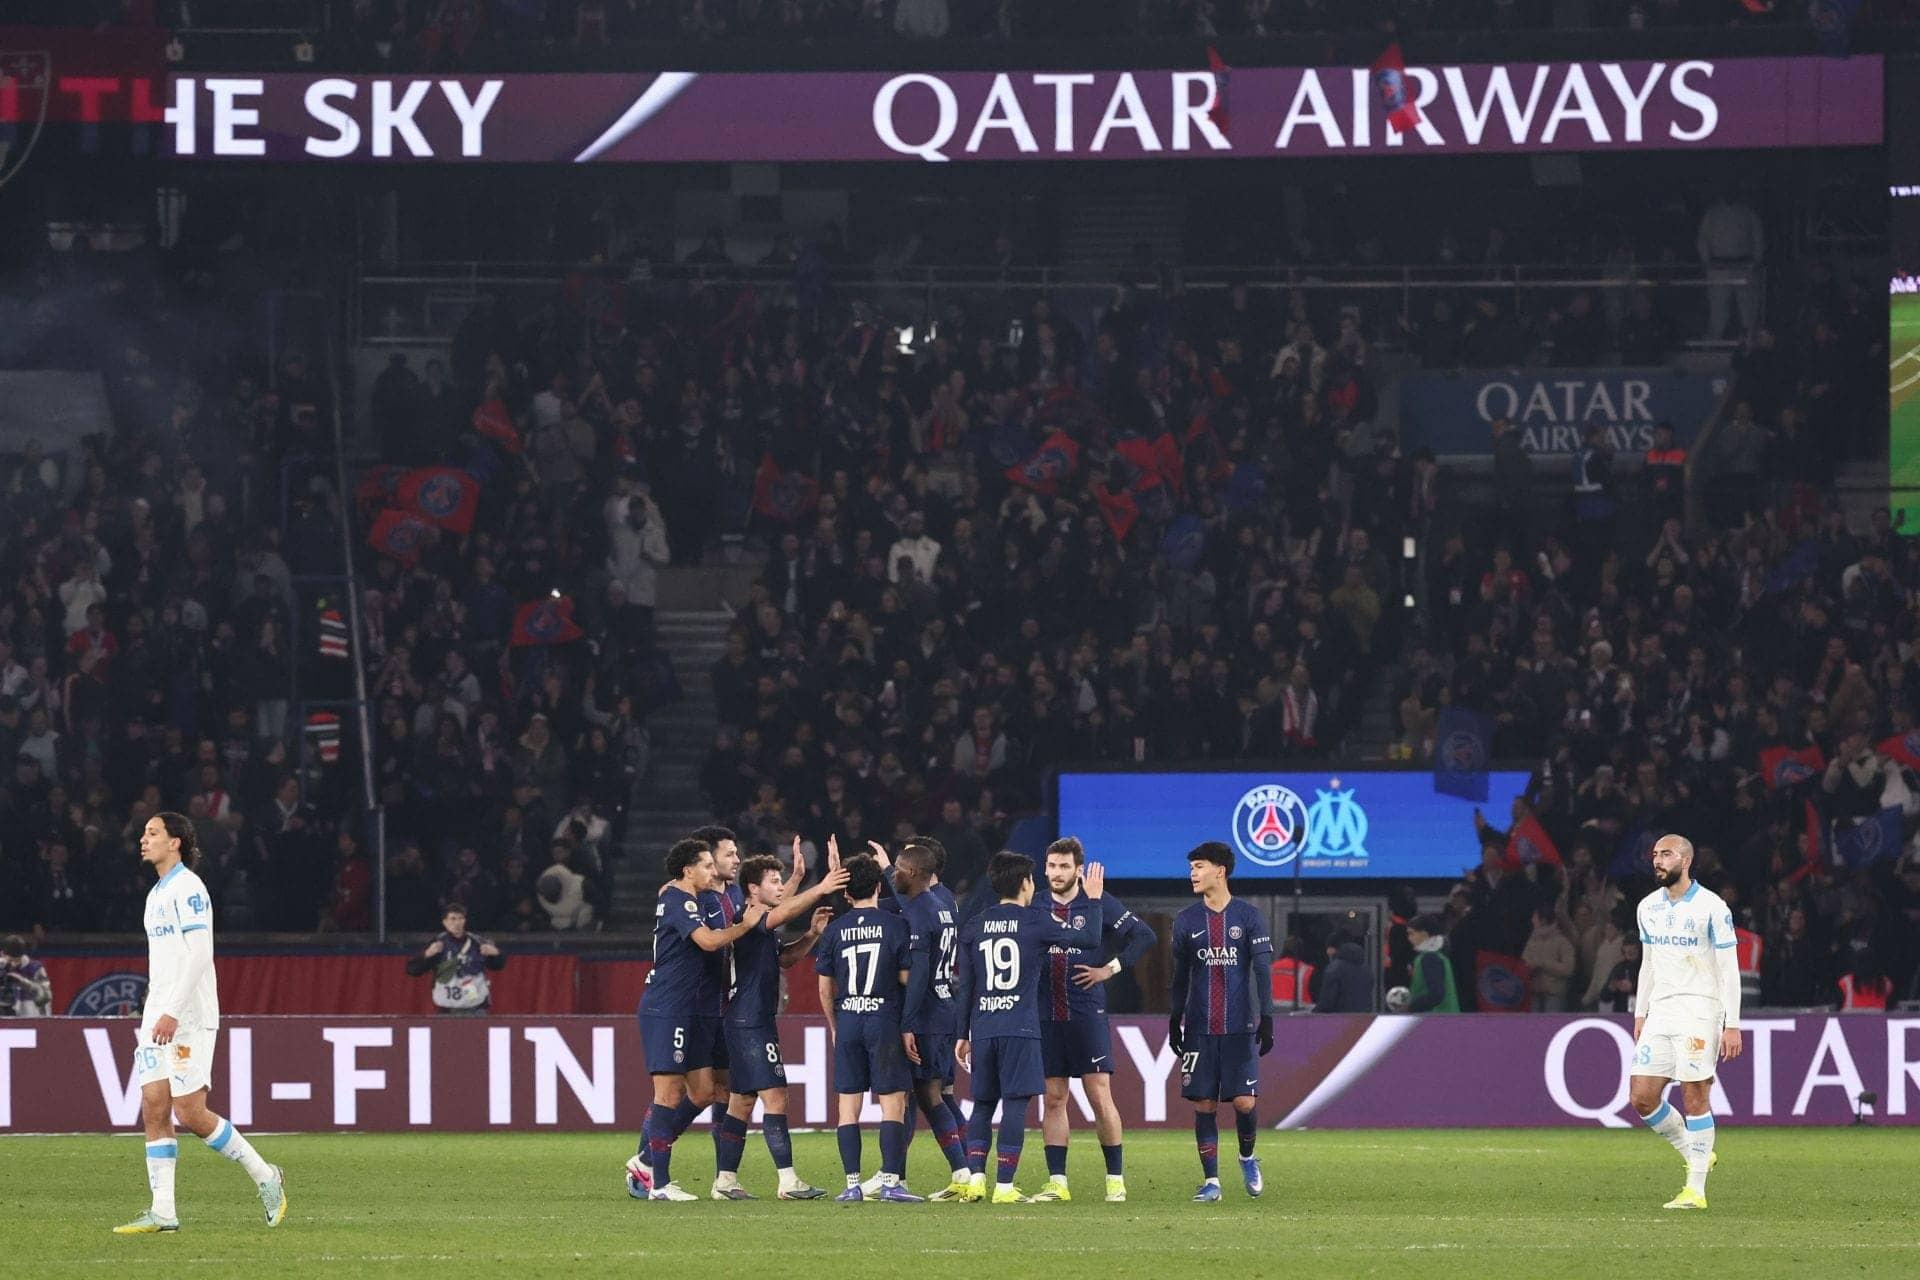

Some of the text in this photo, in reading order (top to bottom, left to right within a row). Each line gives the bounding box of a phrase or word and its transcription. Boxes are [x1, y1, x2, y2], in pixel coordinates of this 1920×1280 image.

[303, 78, 504, 158] SKY
[872, 59, 1720, 163] QATAR AIRWAYS
[840, 925, 883, 942] VITINHA
[984, 919, 1019, 934] KANG IN
[1197, 946, 1238, 961] QATAR
[1205, 957, 1238, 966] AIRWAYS
[841, 942, 881, 996] 17
[978, 937, 1021, 992] 19
[841, 996, 879, 1014] snipes
[673, 1027, 685, 1048] 5
[1181, 1052, 1200, 1073] 27
[489, 1026, 616, 1125] IN
